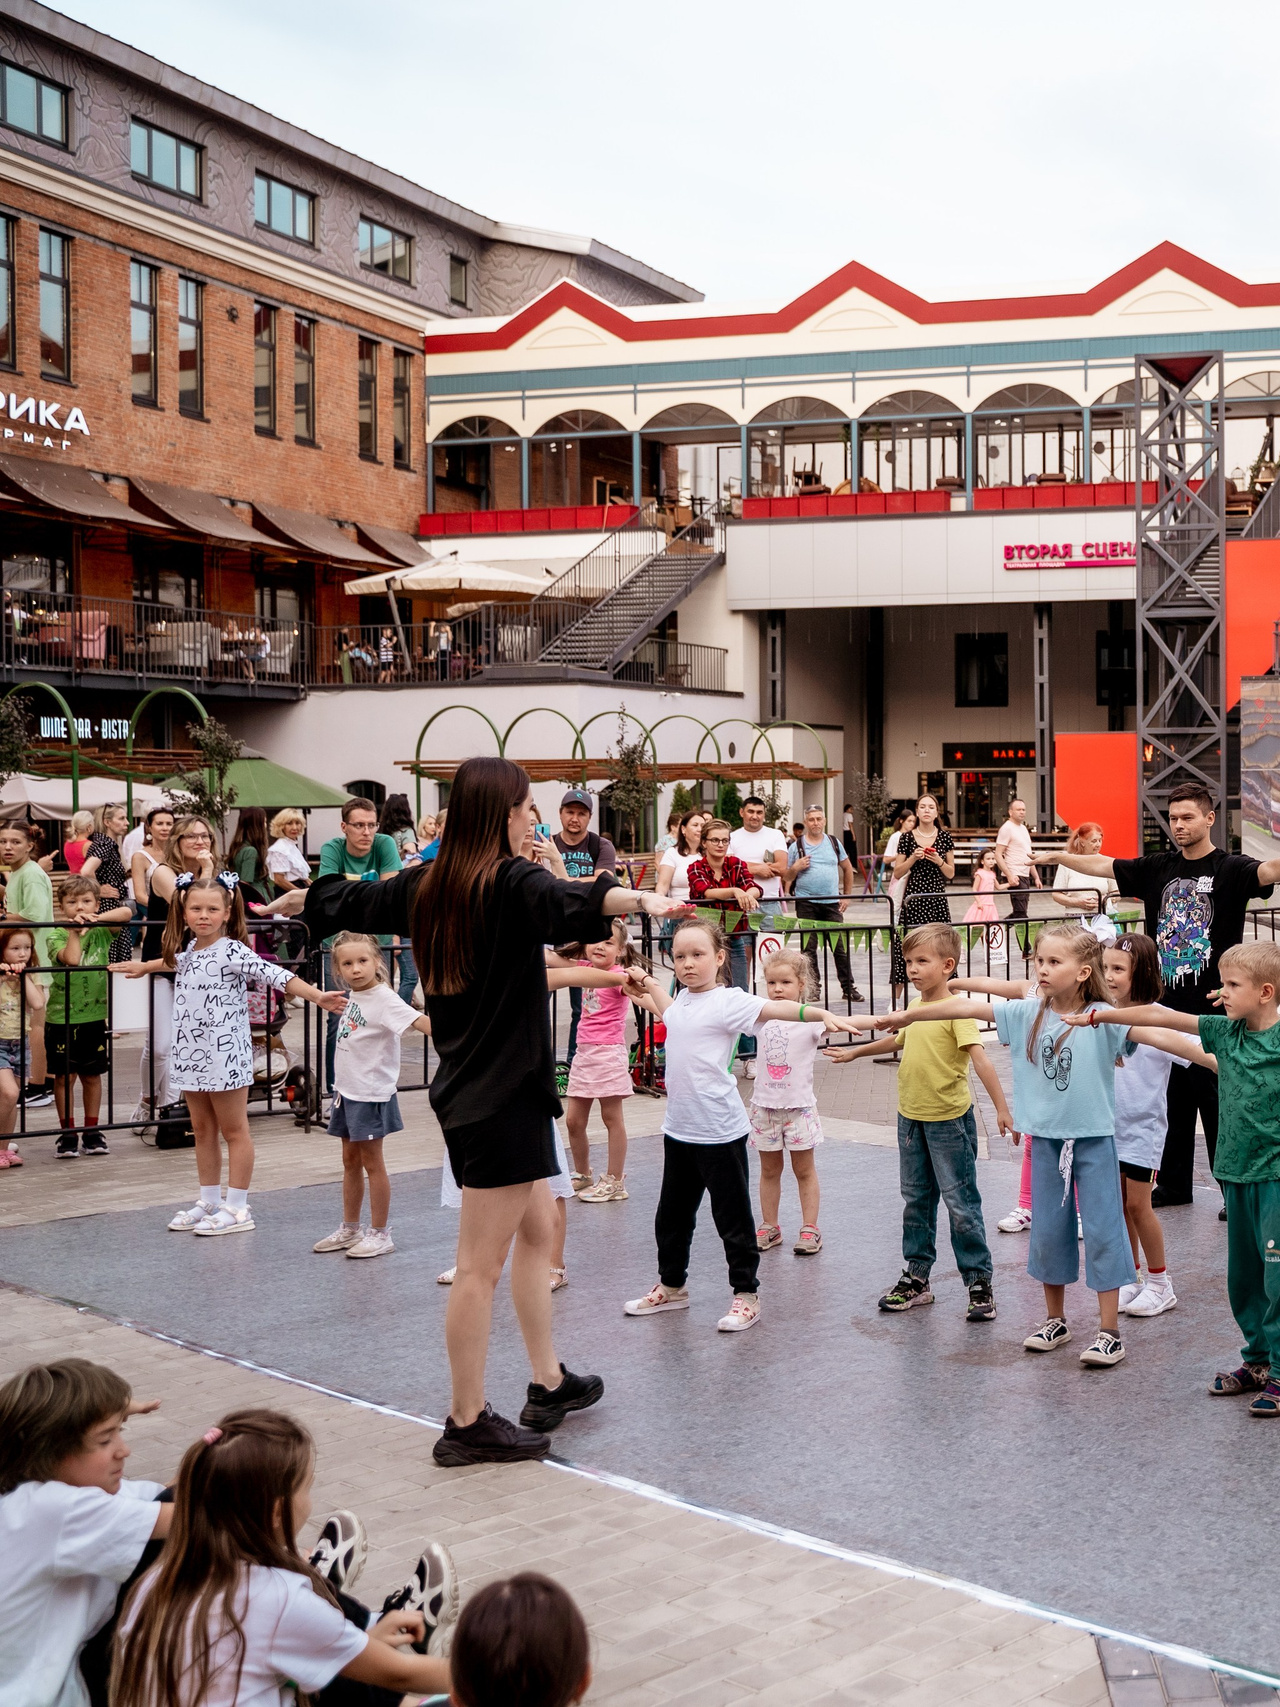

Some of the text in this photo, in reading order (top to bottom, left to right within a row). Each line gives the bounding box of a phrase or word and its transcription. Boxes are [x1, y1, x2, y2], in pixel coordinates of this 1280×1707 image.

[4, 428, 71, 450] РМАГ
[1004, 541, 1136, 560] ВТОРАЯ СЦЕН
[40, 716, 67, 738] WINE
[102, 718, 135, 740] BISTR
[993, 749, 1015, 758] BAR
